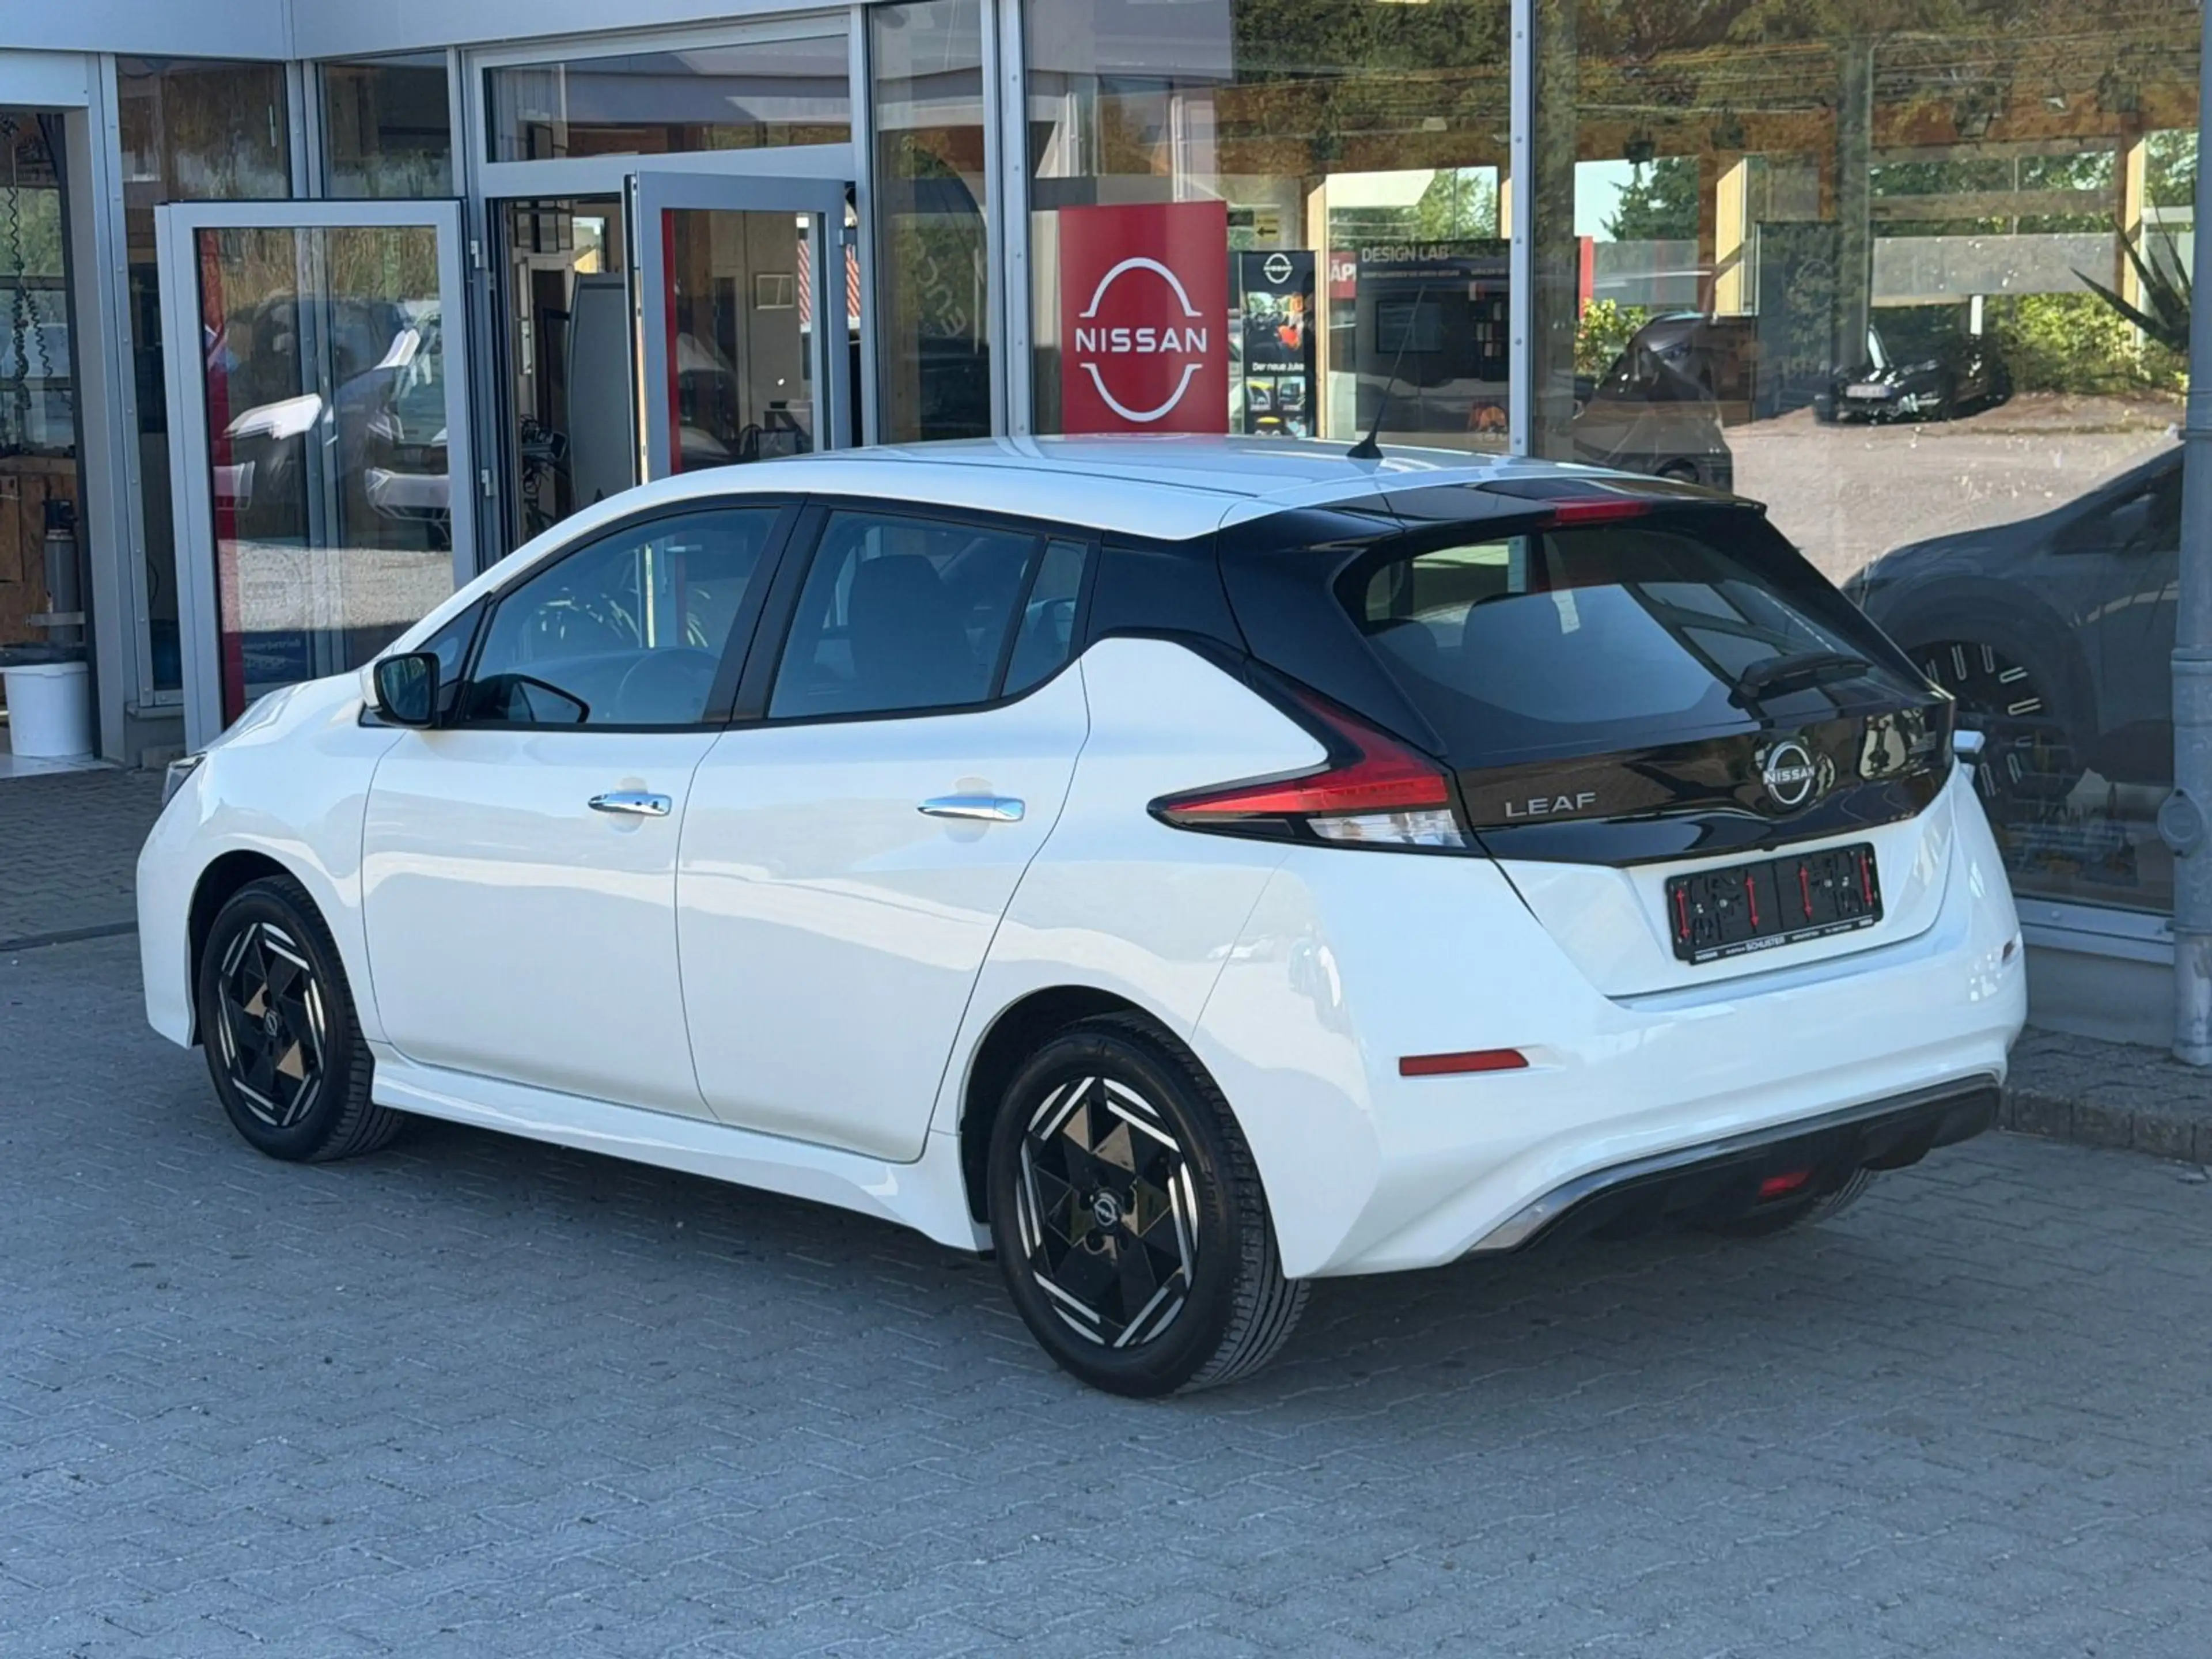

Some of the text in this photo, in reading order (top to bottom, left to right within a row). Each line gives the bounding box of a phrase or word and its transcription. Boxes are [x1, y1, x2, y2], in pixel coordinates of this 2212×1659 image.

[1362, 245, 1450, 263] DESIGN LAB
[1075, 327, 1207, 353] NISSAN
[1763, 765, 1815, 785] NISSAN
[1505, 791, 1596, 818] LEAF
